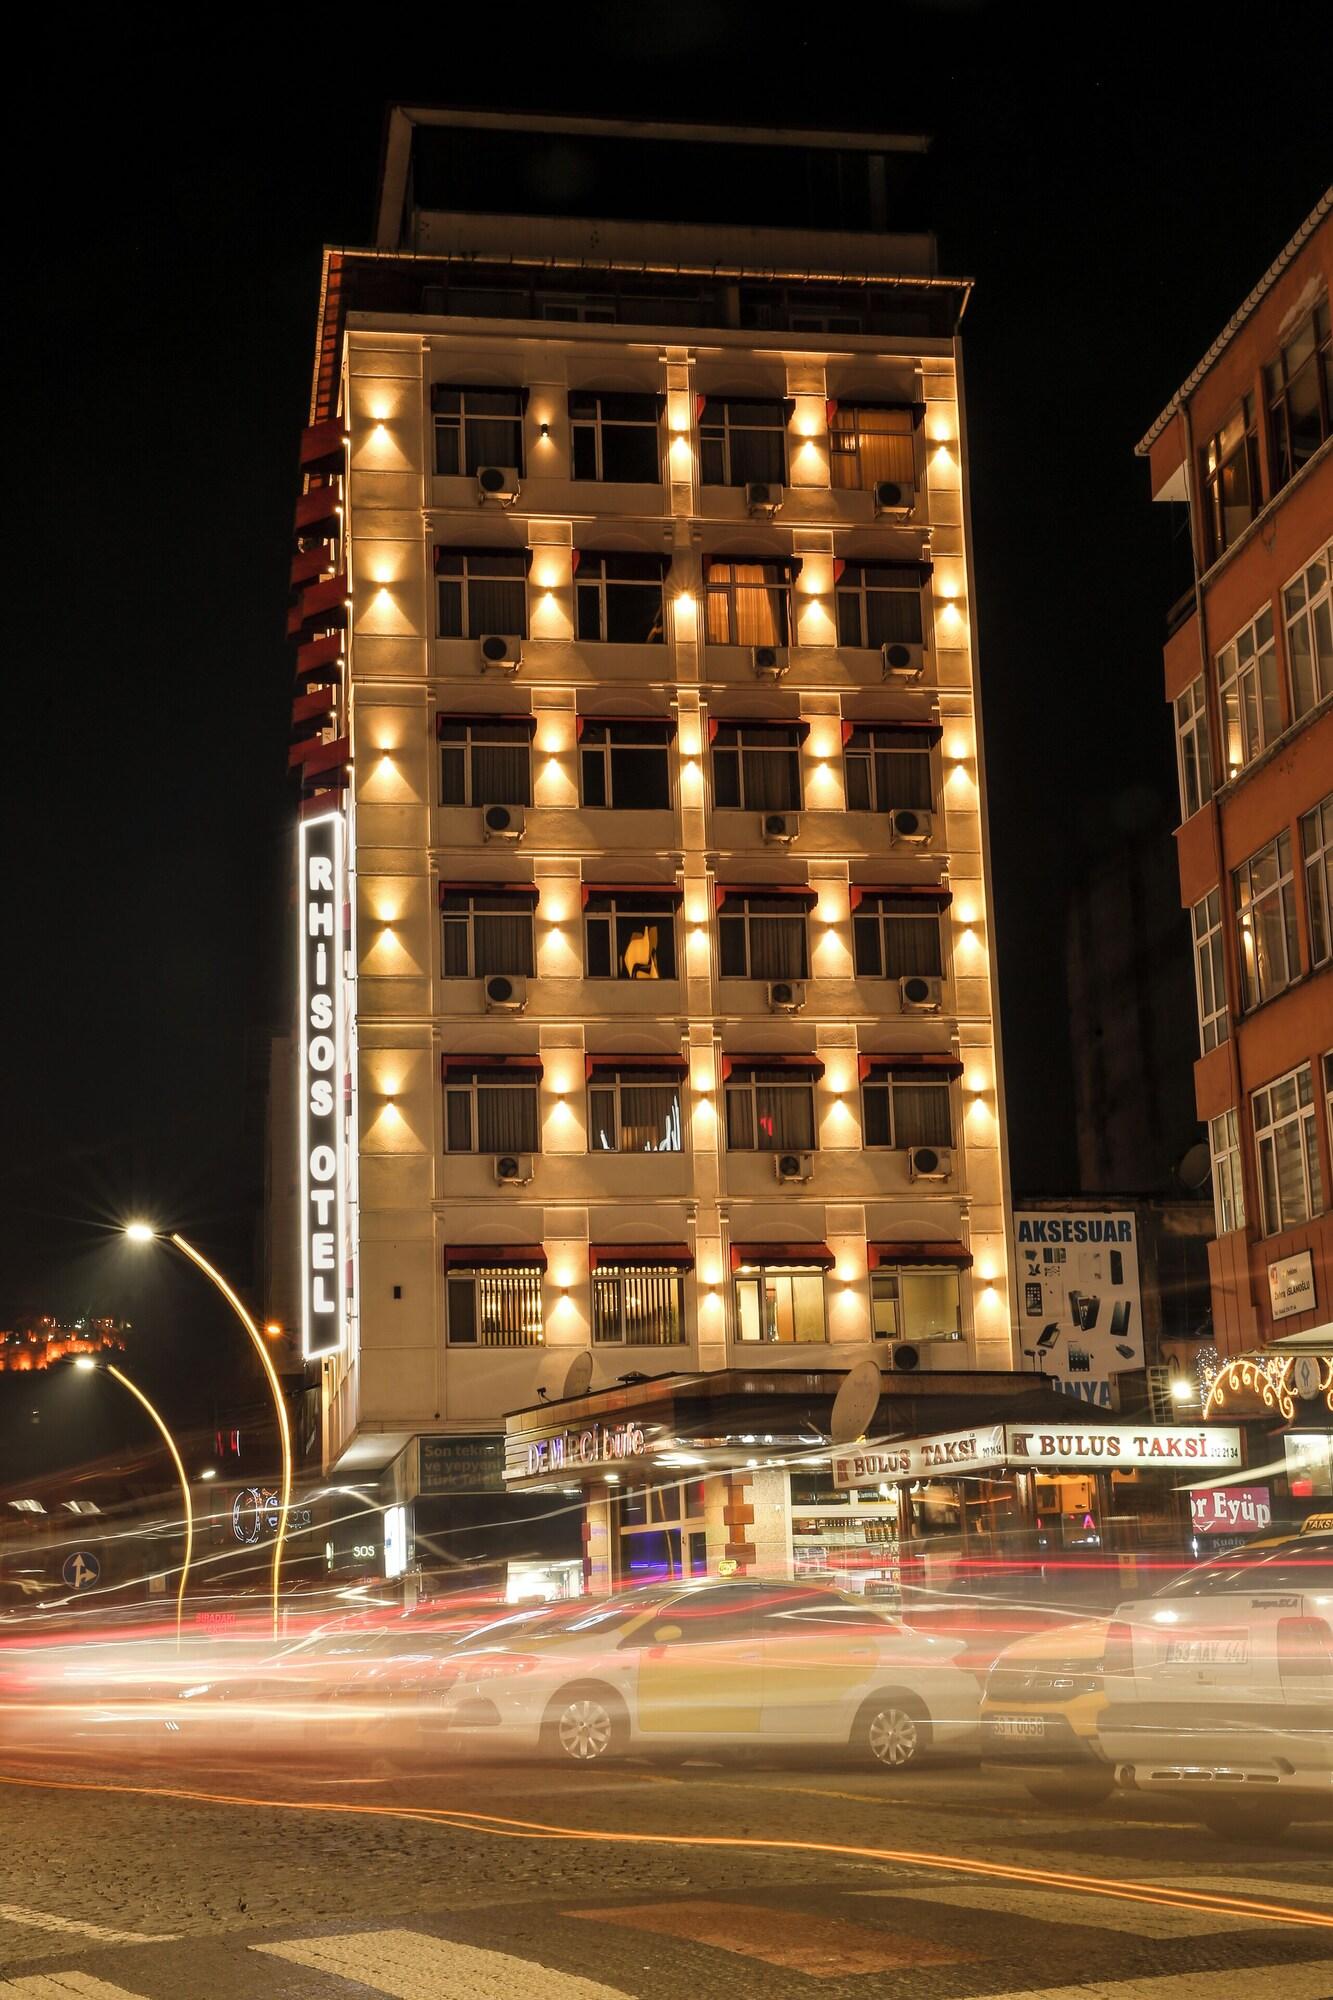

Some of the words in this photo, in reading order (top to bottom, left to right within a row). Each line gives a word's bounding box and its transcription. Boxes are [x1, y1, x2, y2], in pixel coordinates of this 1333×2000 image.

[310, 1146, 336, 1313] OTEL
[1018, 1220, 1132, 1243] AKSESUAR
[1133, 1433, 1208, 1458] TAKSİ
[1212, 1491, 1272, 1529] Eyüp
[353, 1545, 375, 1557] SOS
